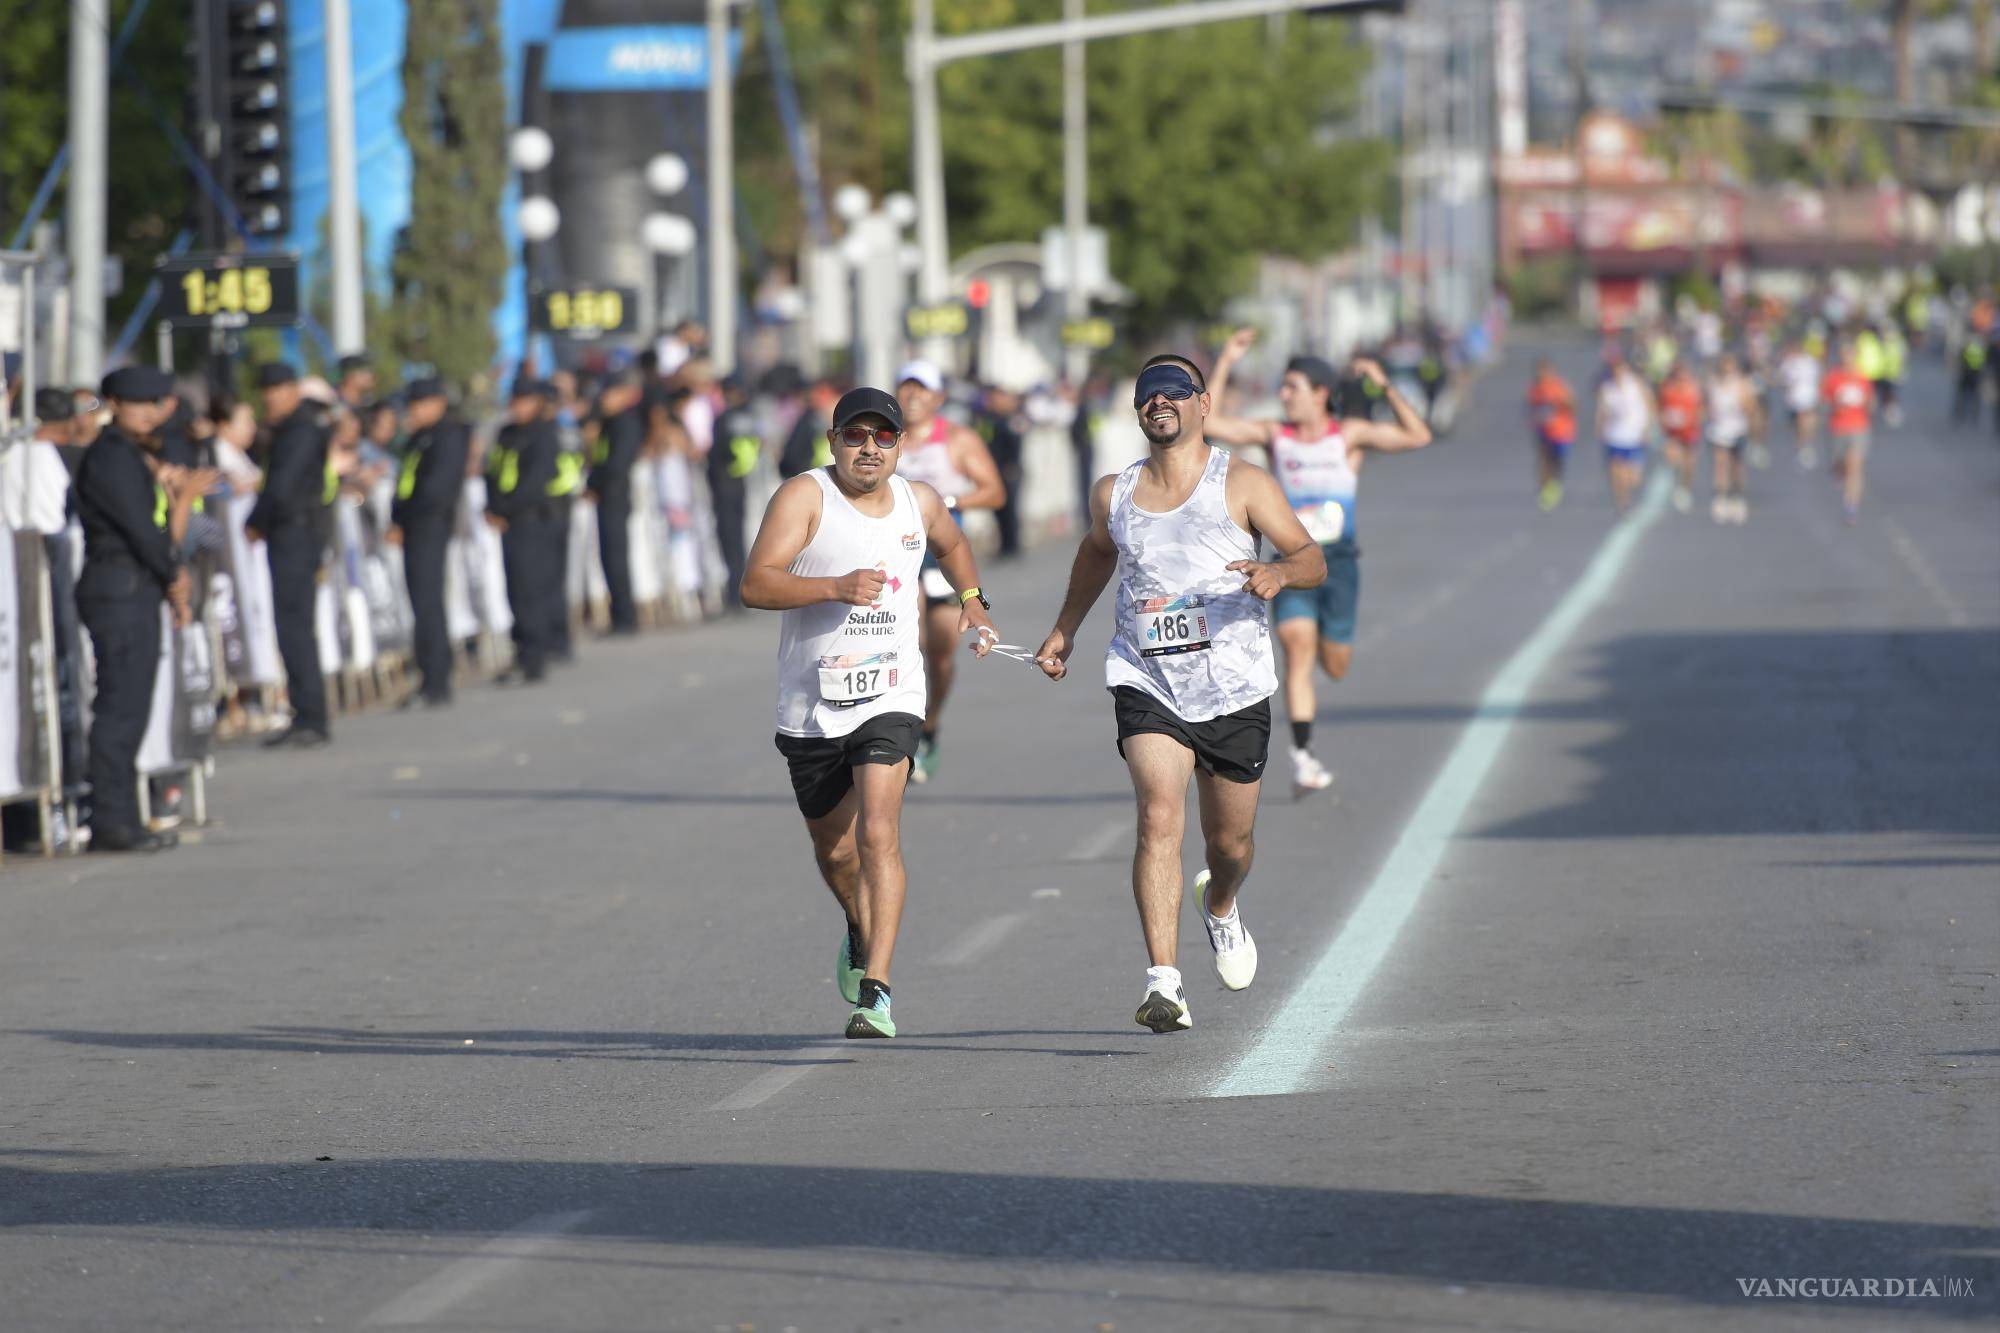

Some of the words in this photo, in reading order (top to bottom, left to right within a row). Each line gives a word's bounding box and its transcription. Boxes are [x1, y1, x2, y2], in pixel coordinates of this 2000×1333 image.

[182, 267, 272, 315] 1:45
[848, 611, 896, 624] Saltillo
[1153, 615, 1190, 641] 186
[845, 626, 868, 635] nos
[872, 626, 895, 635] une.
[844, 670, 880, 694] 187
